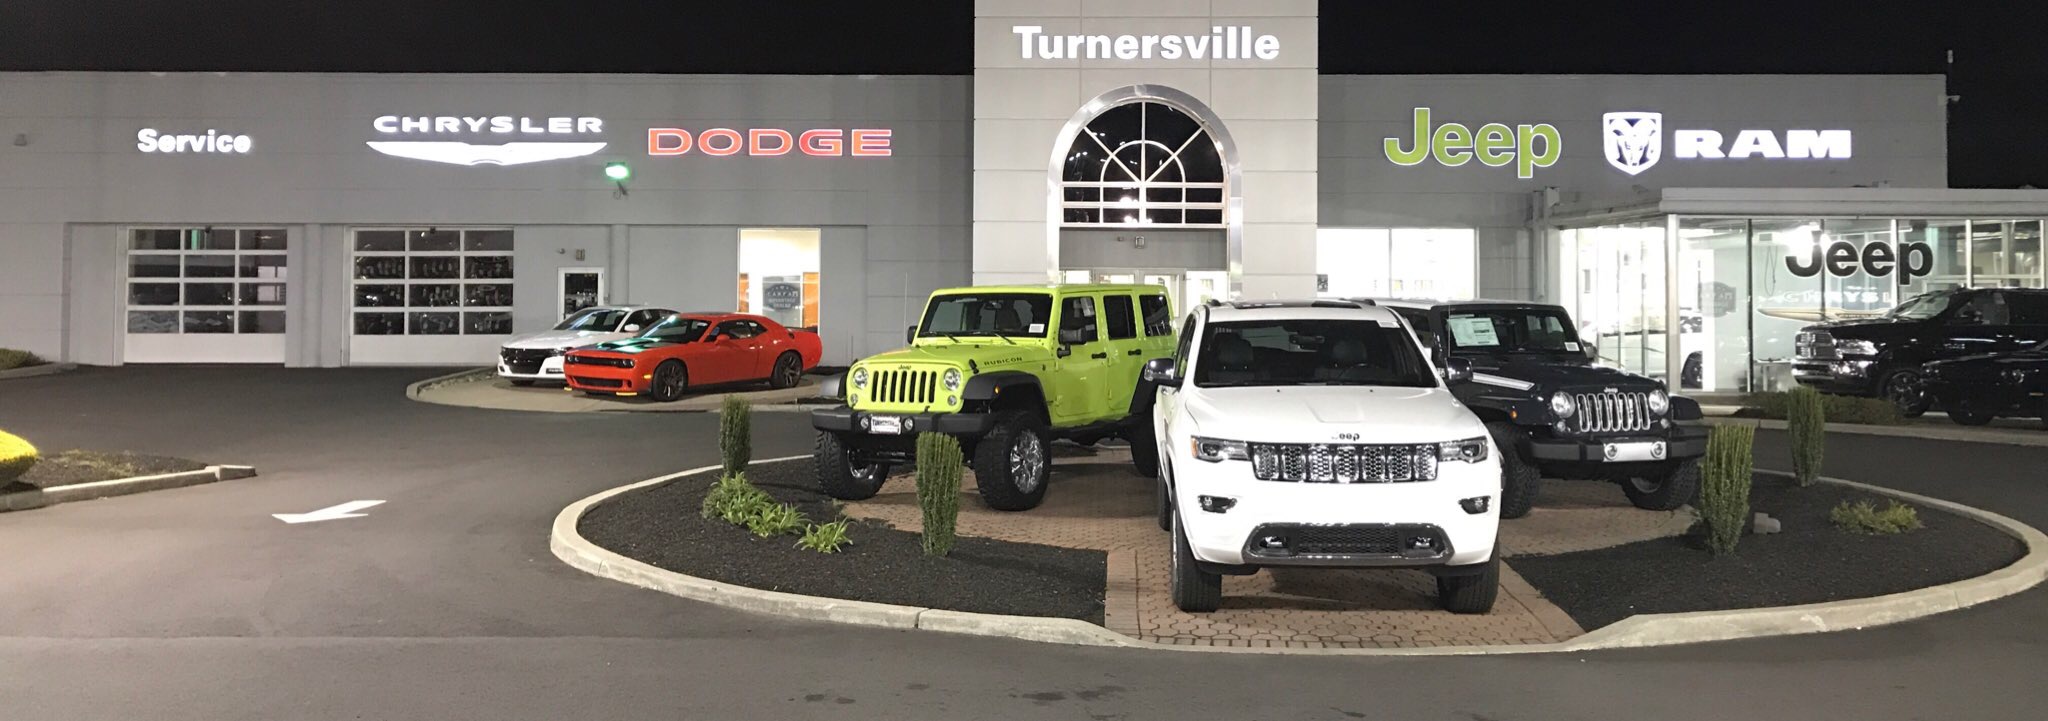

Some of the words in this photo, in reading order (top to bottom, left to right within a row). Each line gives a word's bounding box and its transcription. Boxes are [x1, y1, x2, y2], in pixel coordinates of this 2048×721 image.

[1013, 26, 1280, 60] Turnersville
[372, 114, 605, 134] CHRYSLER
[137, 128, 252, 153] Service
[648, 128, 891, 156] DODGE
[1384, 107, 1562, 179] Jeep
[1674, 129, 1852, 159] RAM
[1785, 231, 1934, 285] Jeep
[984, 357, 1023, 366] RUBICON
